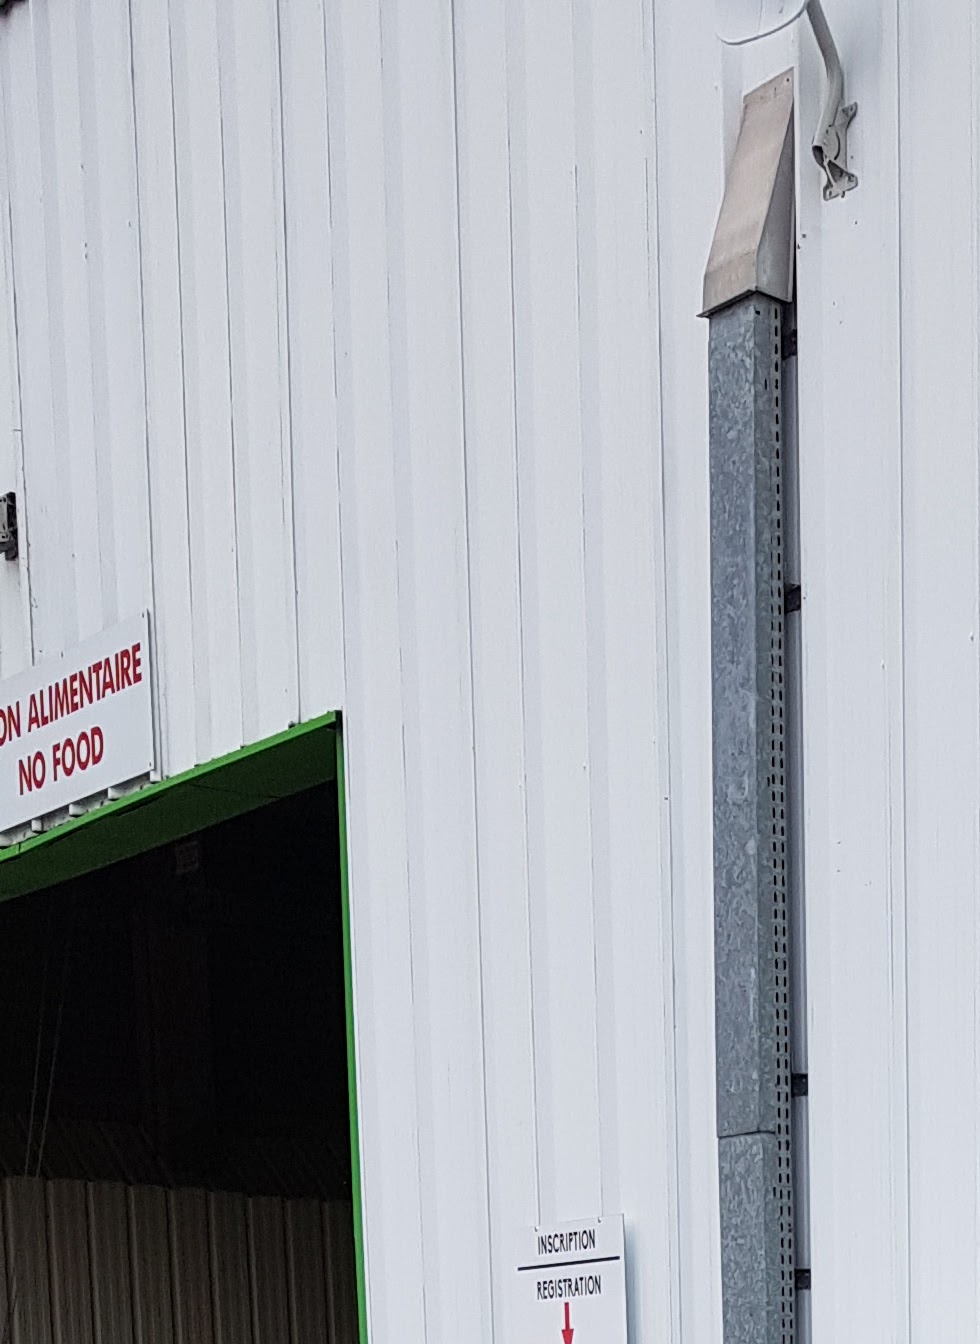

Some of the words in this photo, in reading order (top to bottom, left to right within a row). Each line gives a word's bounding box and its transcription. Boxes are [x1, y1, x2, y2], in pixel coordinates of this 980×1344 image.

[27, 642, 143, 733] ALIMENTAIRE
[18, 751, 47, 796] NO
[52, 726, 104, 782] FOOD
[537, 1229, 596, 1256] INSCRIPTION
[536, 1275, 602, 1300] REGISTRATION
